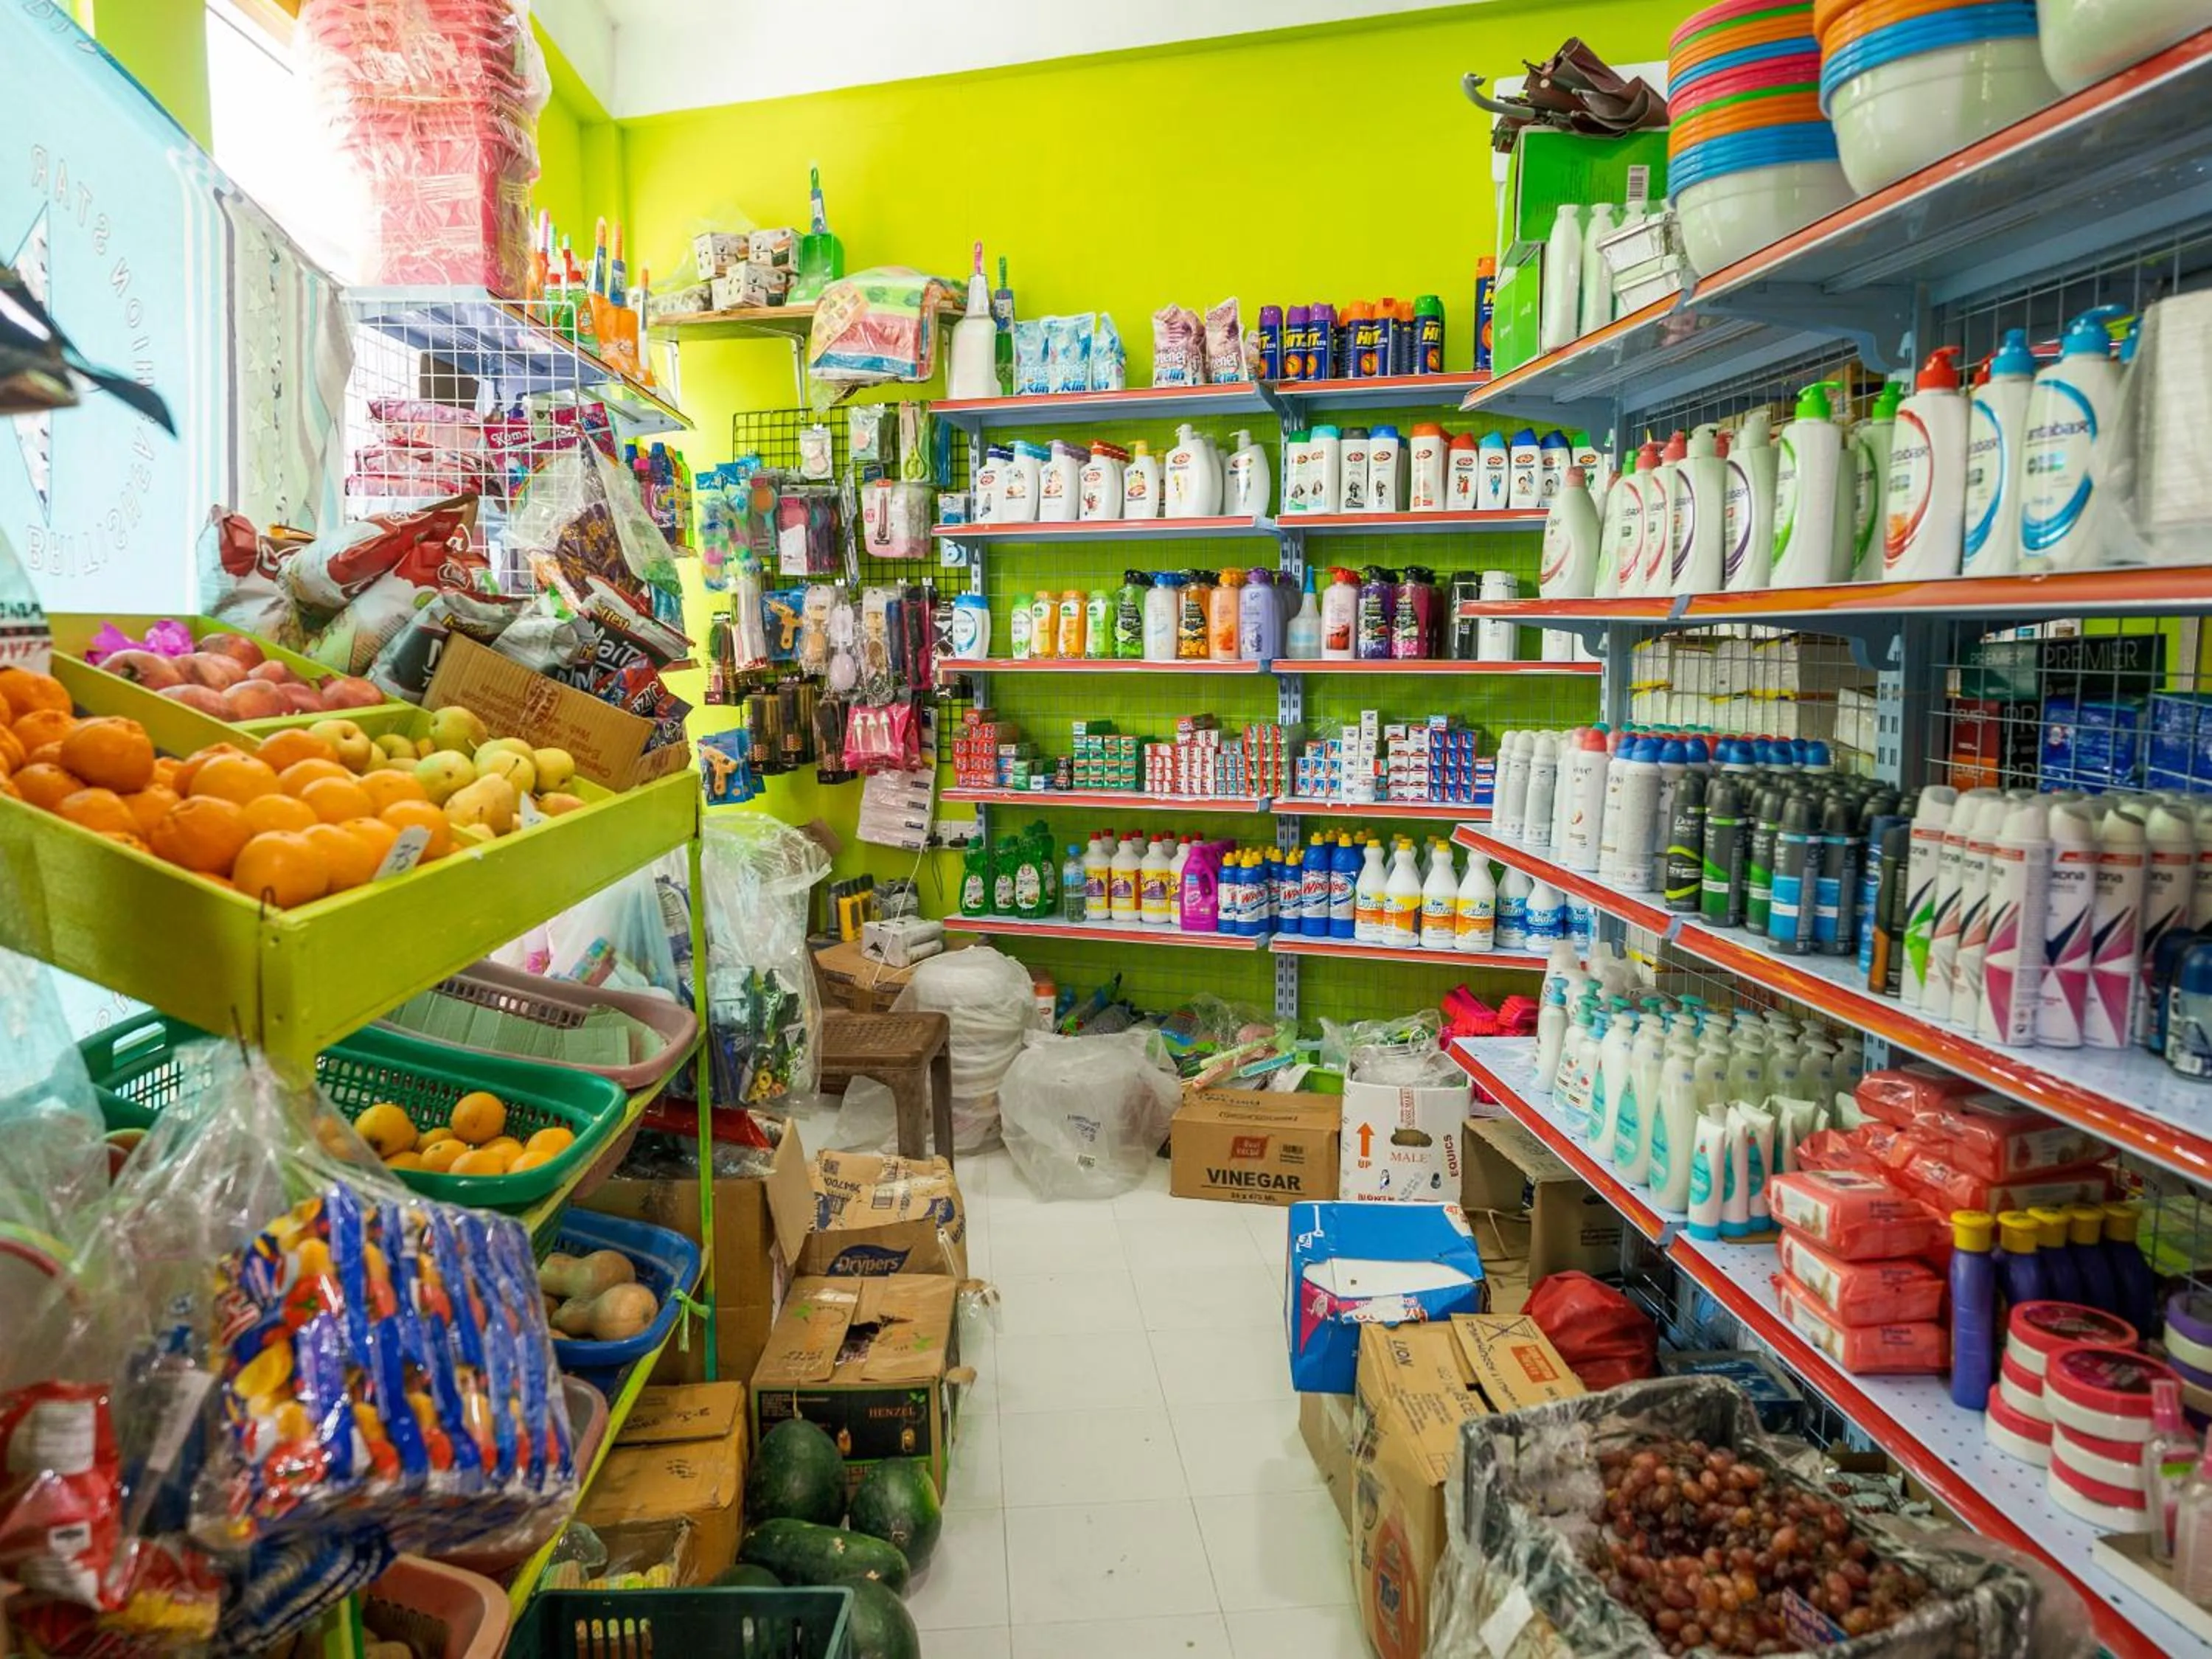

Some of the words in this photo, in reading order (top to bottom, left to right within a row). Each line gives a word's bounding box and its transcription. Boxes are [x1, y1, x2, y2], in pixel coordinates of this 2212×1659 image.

[2045, 639, 2139, 670] PREMIER
[1357, 1160, 1371, 1169] UP
[1390, 1152, 1427, 1164] MALE
[1206, 1167, 1301, 1192] VINEGAR
[835, 1256, 900, 1277] Drypers
